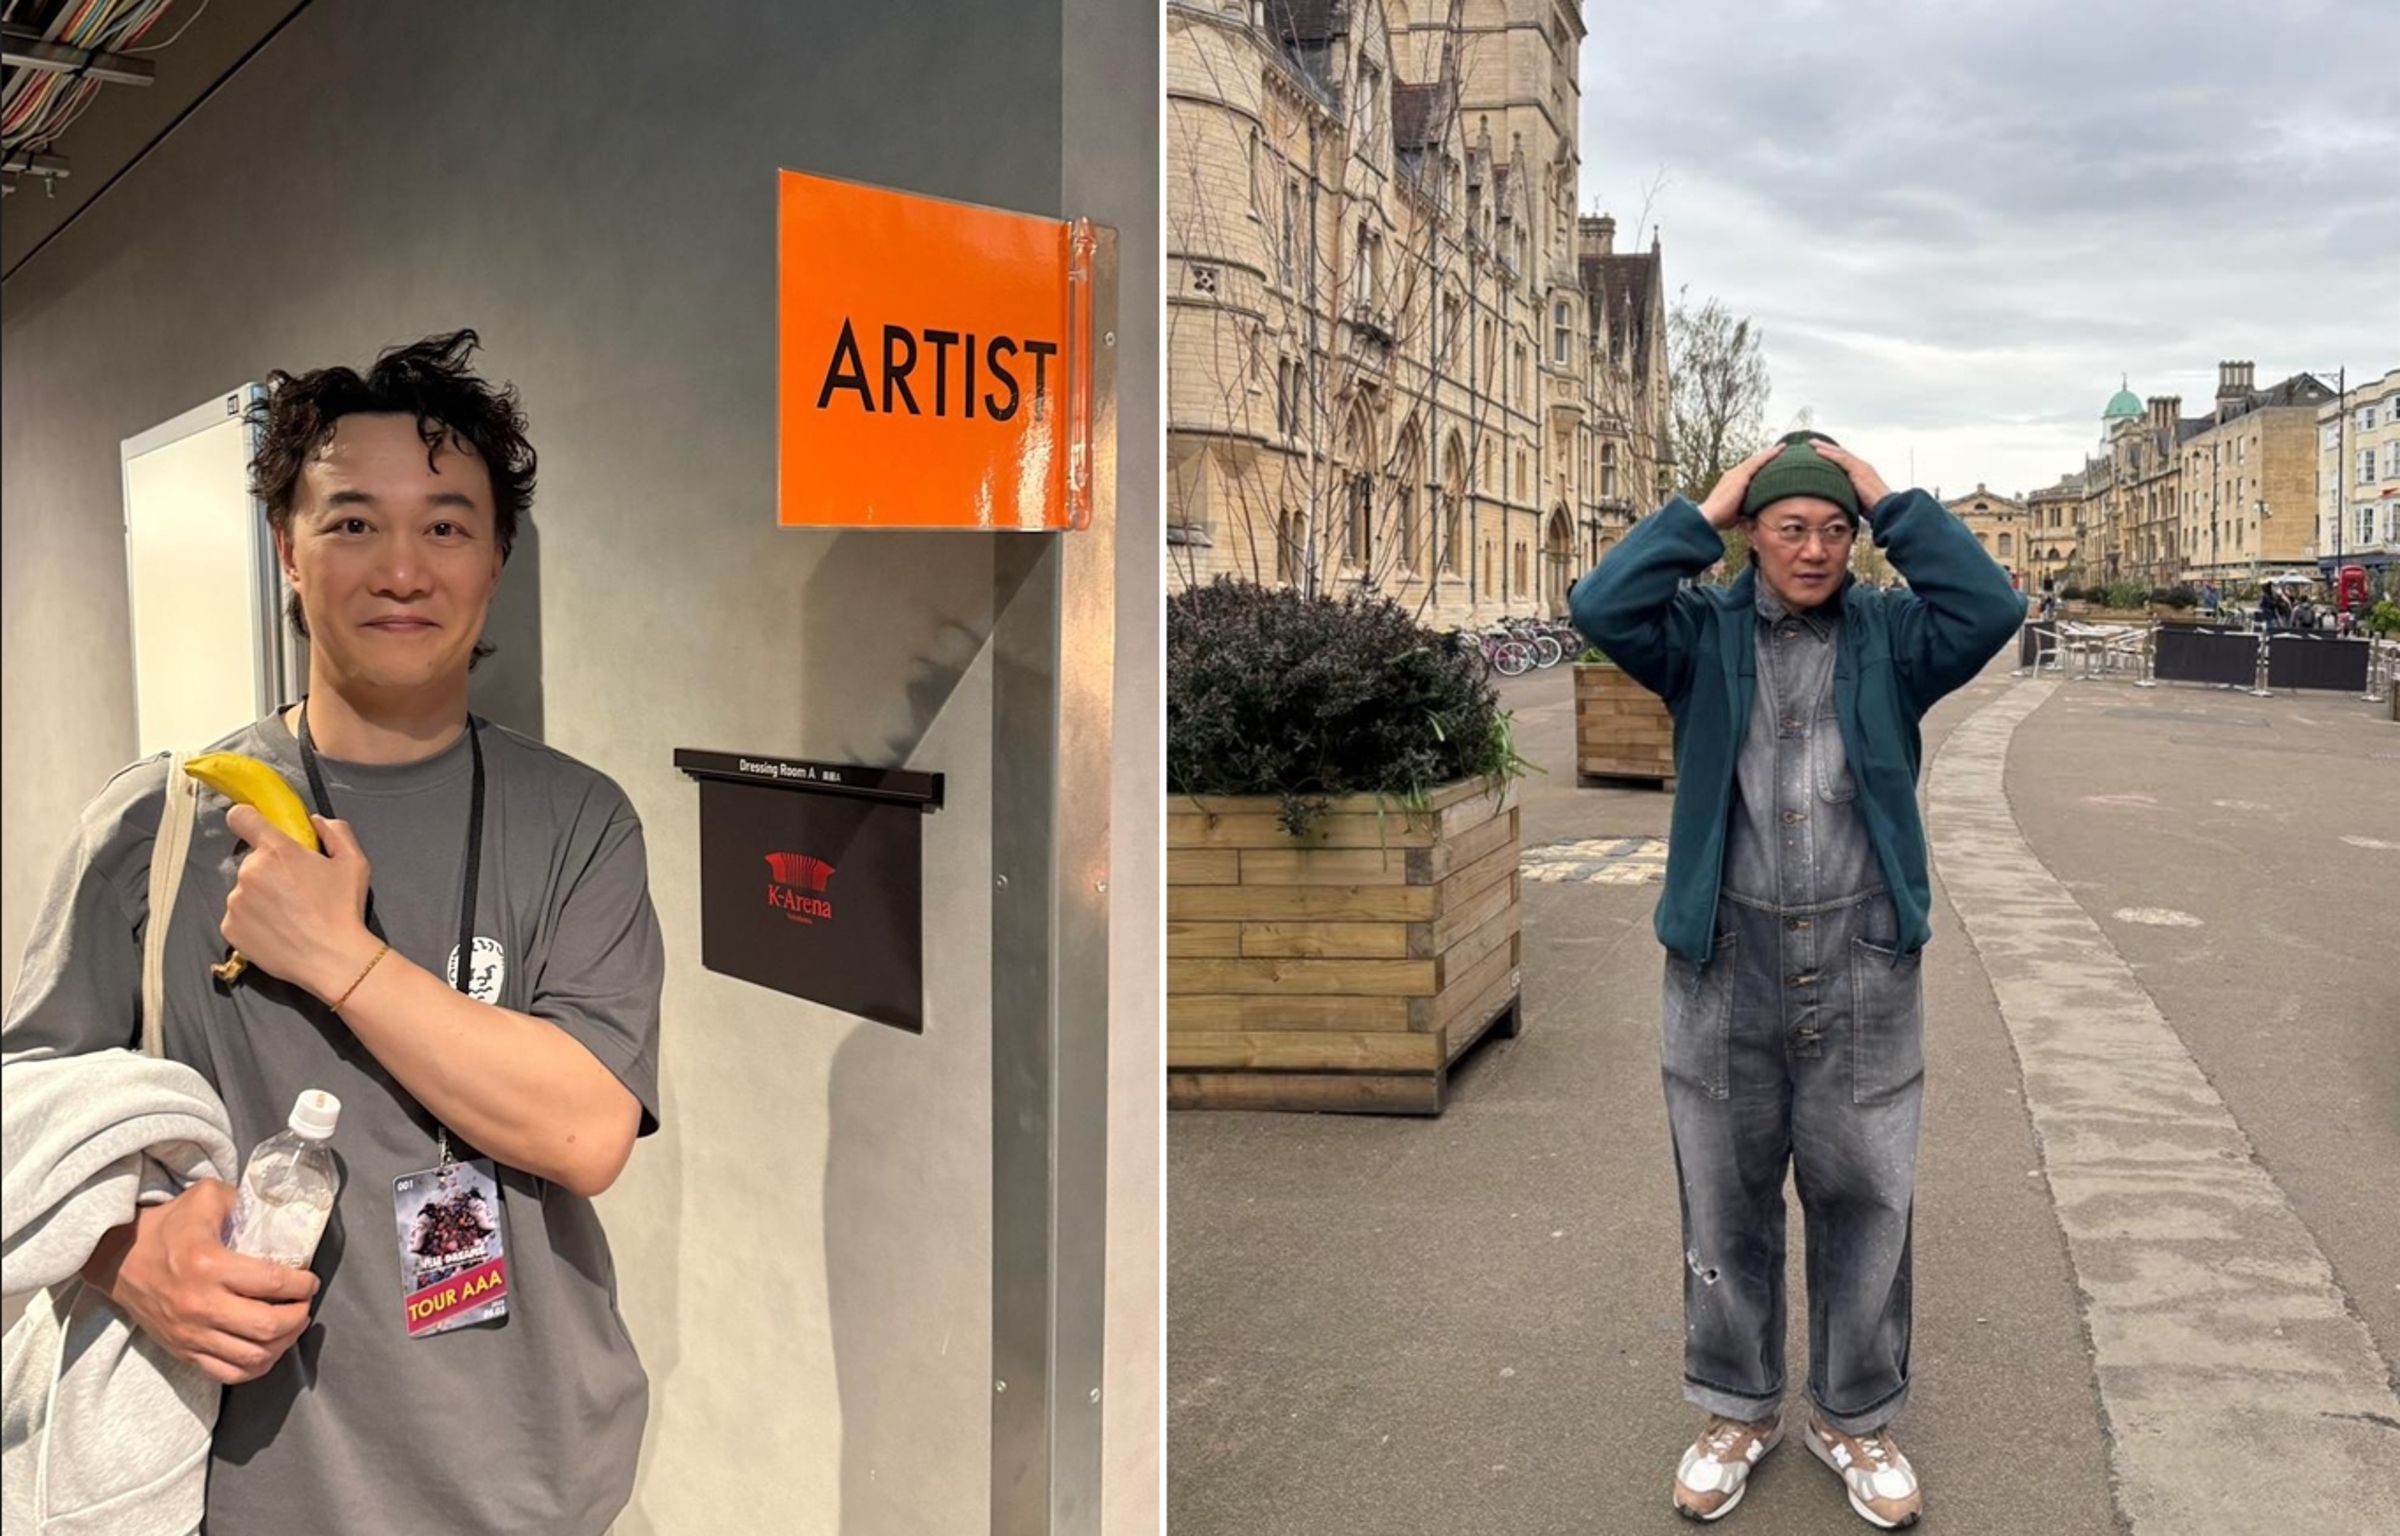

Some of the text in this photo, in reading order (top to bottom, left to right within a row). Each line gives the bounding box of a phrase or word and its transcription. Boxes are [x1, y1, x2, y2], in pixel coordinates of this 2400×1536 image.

[816, 316, 1057, 422] ARTIST
[739, 758, 778, 778] Dressing
[780, 763, 807, 778] Room
[808, 766, 817, 779] A
[768, 884, 833, 919] K-Arena
[408, 1269, 503, 1323] TOUR AAA
